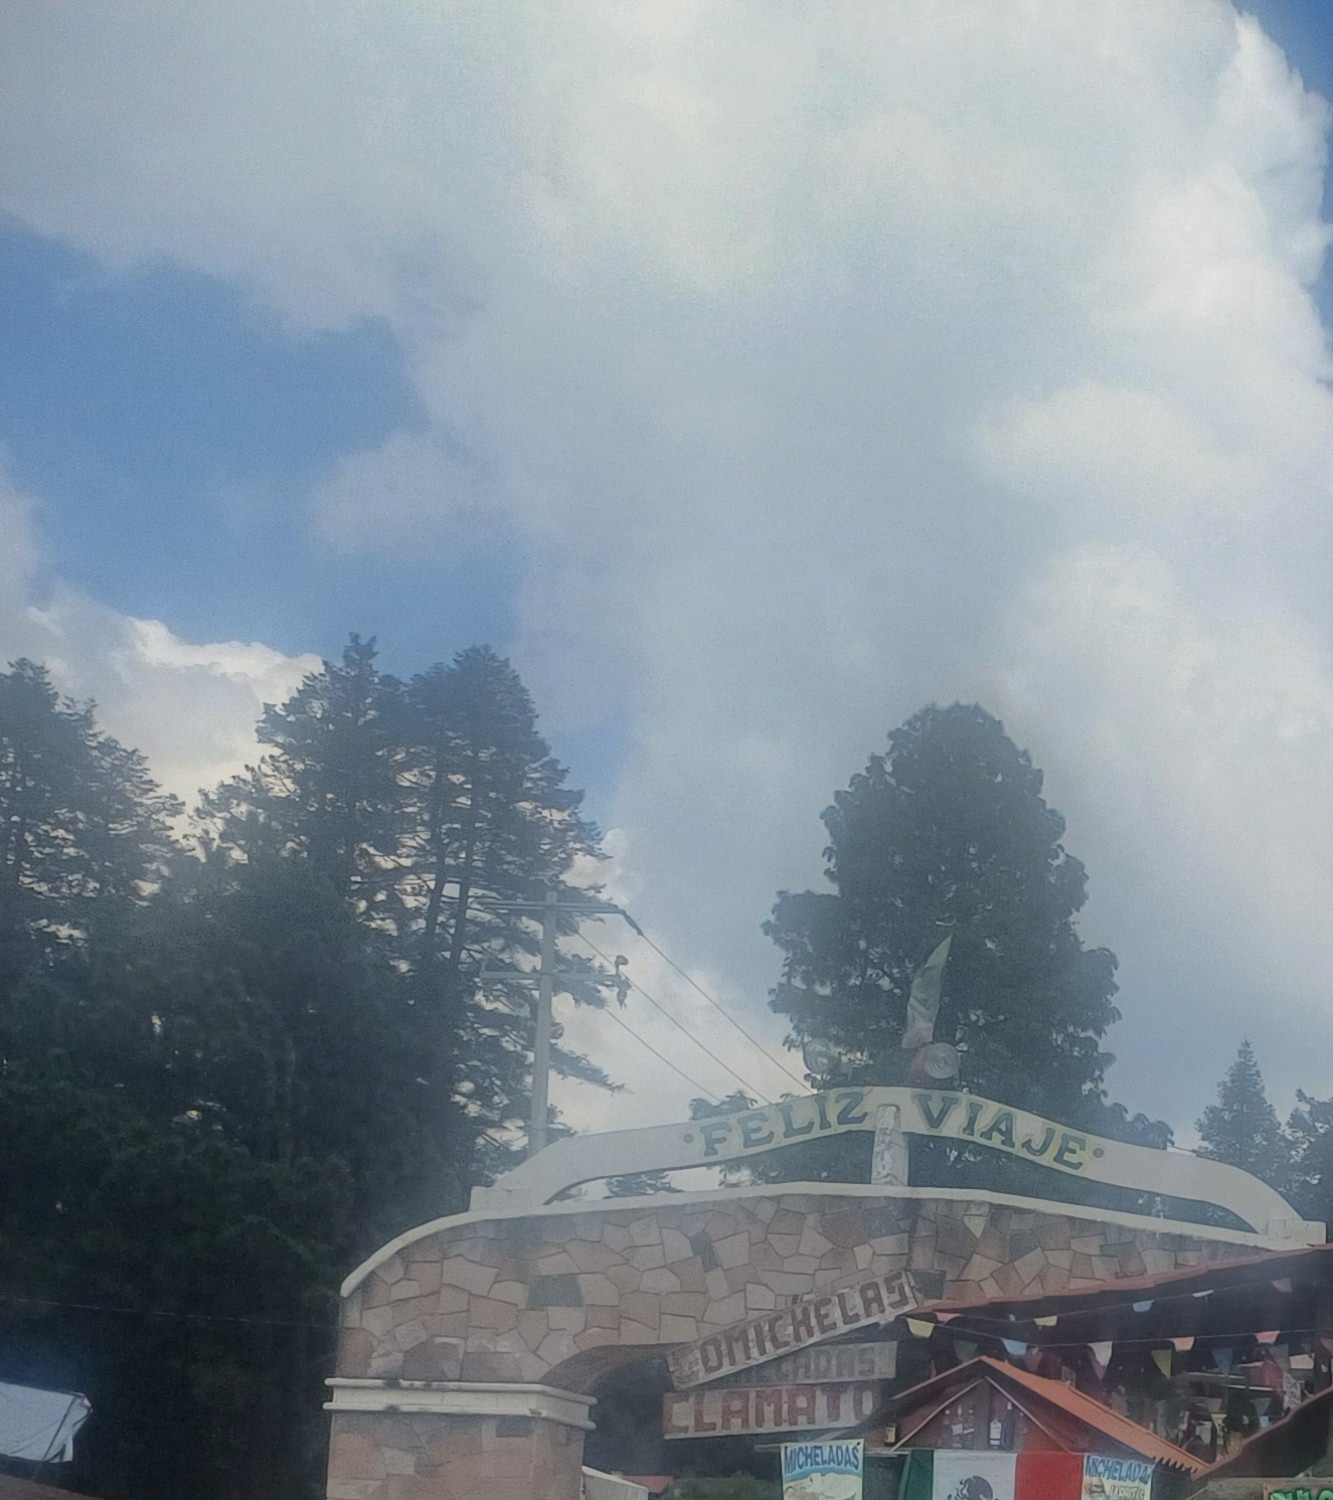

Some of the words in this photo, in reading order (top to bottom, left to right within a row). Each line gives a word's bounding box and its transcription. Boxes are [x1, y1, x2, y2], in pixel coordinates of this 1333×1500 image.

[701, 1091, 869, 1157] FELIZ
[911, 1093, 1087, 1170] VIAJE
[663, 1384, 880, 1436] CLAMATO
[784, 1445, 861, 1474] MICHELADAS
